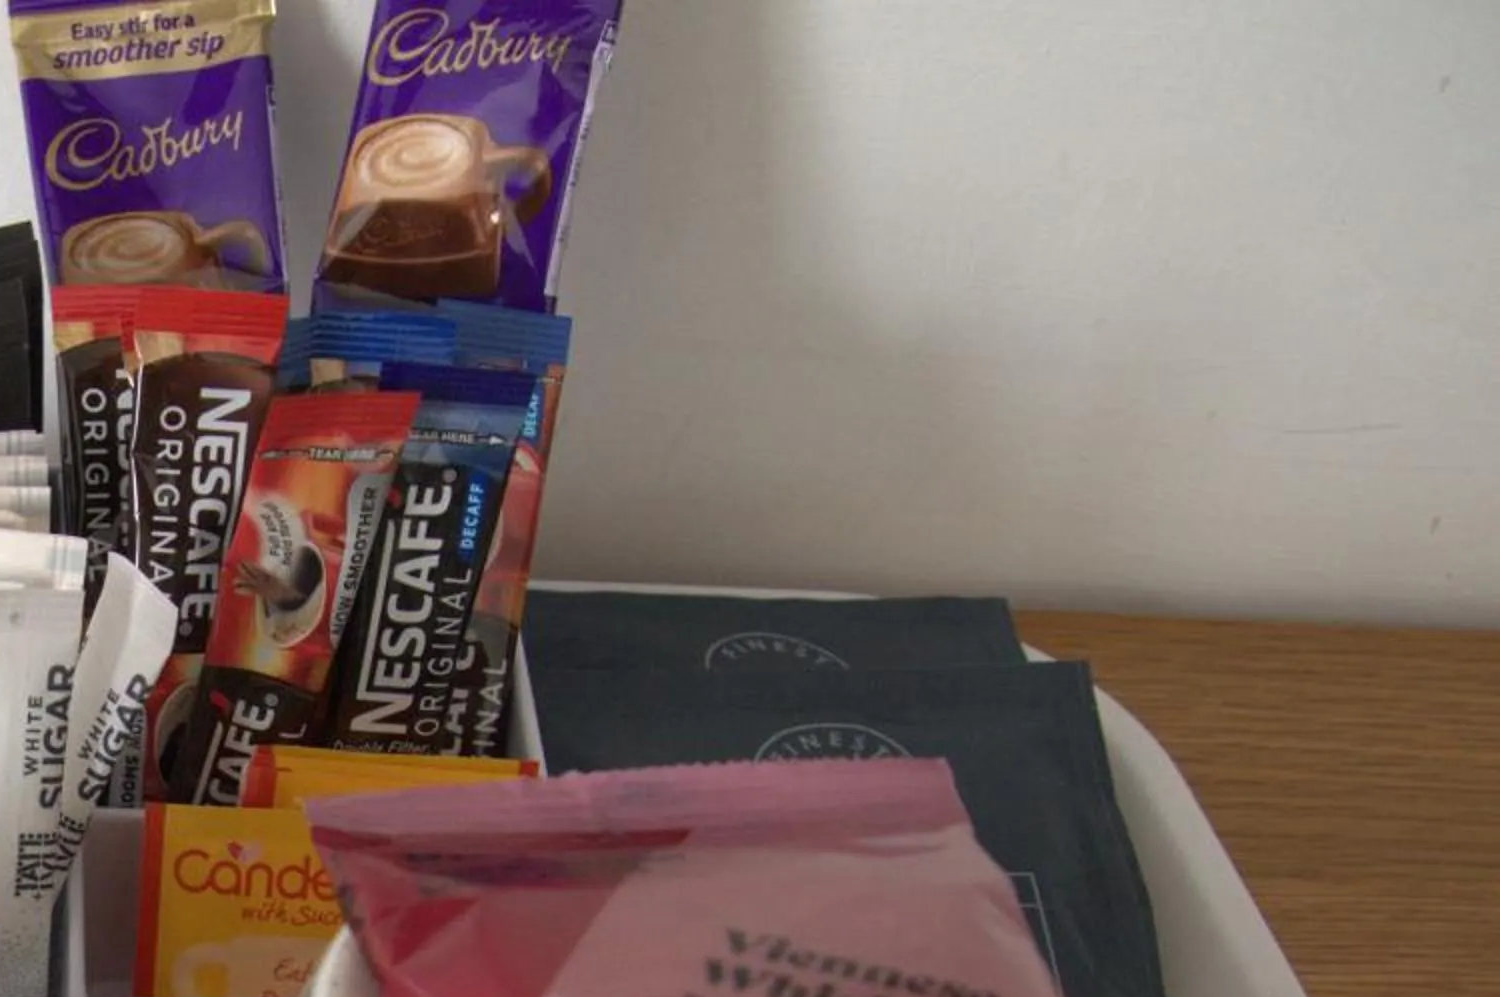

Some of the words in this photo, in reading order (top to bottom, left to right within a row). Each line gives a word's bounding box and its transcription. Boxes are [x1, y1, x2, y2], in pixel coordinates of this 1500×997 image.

[53, 36, 182, 69] smoother
[185, 31, 226, 60] sip
[71, 22, 113, 41] Easy
[119, 15, 149, 34] stir
[153, 14, 180, 32] for
[184, 14, 197, 28] a
[368, 8, 573, 86] Cadbury
[45, 111, 243, 190] Cadbury
[81, 388, 113, 583] ORIGINAL
[149, 405, 188, 600] ORIGINA
[459, 482, 485, 550] DECAFF
[344, 486, 378, 594] SMOOTHER
[414, 567, 473, 737] ORIGINAL
[24, 695, 43, 777] WHITE
[40, 664, 76, 810] SUGAR
[78, 688, 121, 761] WHITE
[78, 673, 151, 802] SUGAR
[173, 848, 336, 902] Cande
